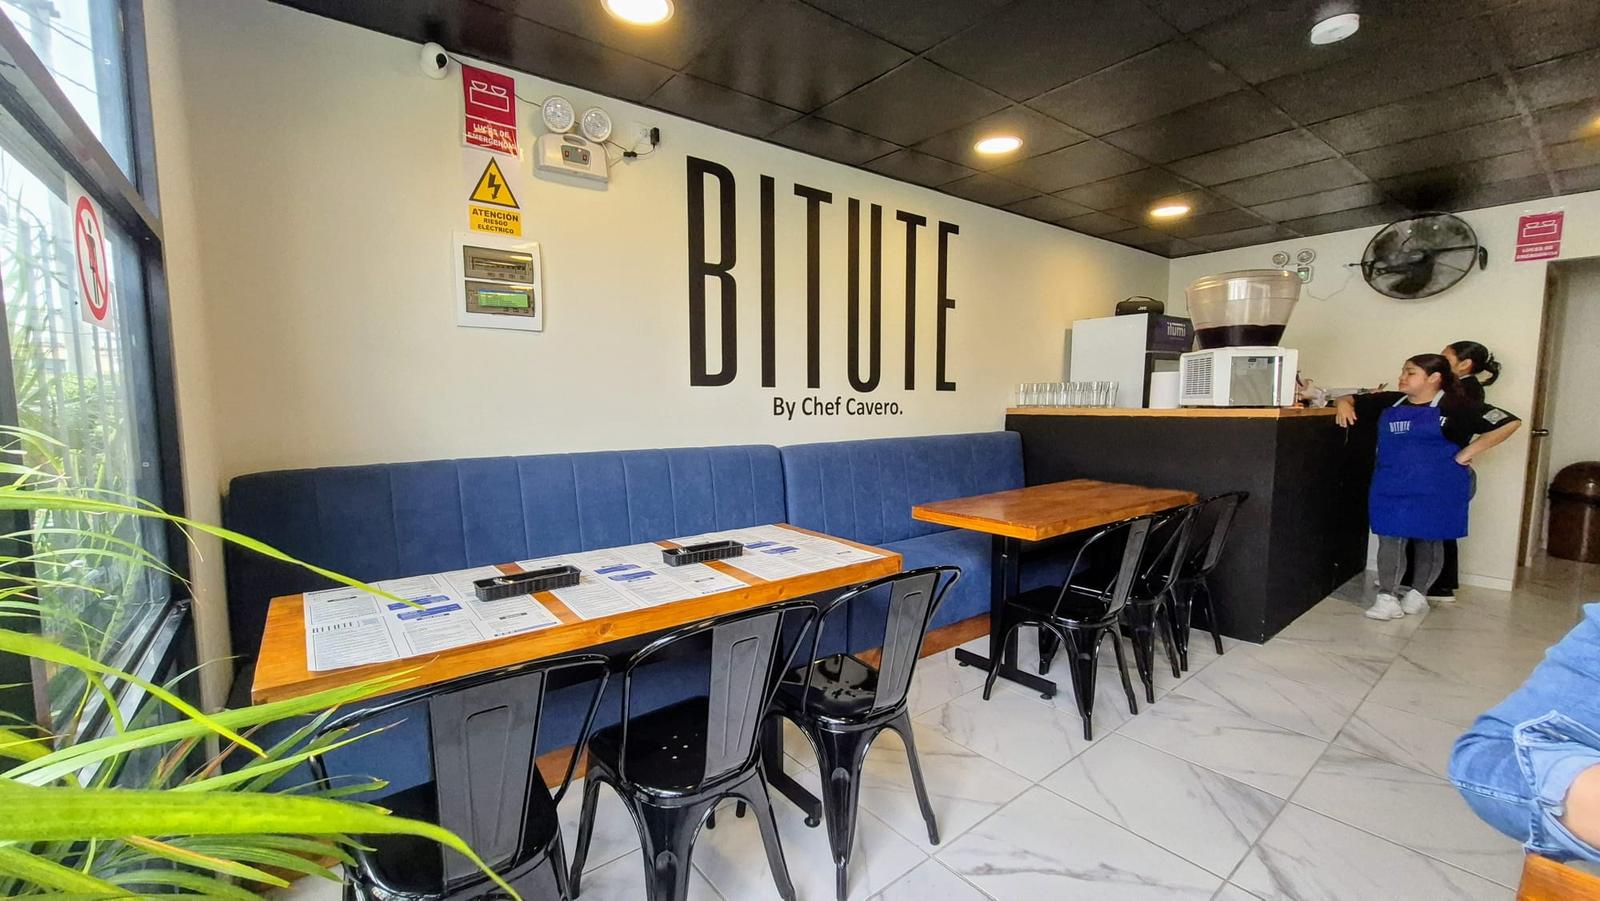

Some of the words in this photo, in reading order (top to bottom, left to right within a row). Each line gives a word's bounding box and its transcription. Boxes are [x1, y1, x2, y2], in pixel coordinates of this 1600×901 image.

[500, 130, 510, 139] DE
[472, 208, 519, 222] ATENCIÓN
[483, 217, 508, 227] RIESGO
[686, 154, 960, 393] BITUTE
[773, 396, 796, 420] By
[801, 396, 842, 416] Chef
[846, 397, 903, 416] Cavero.
